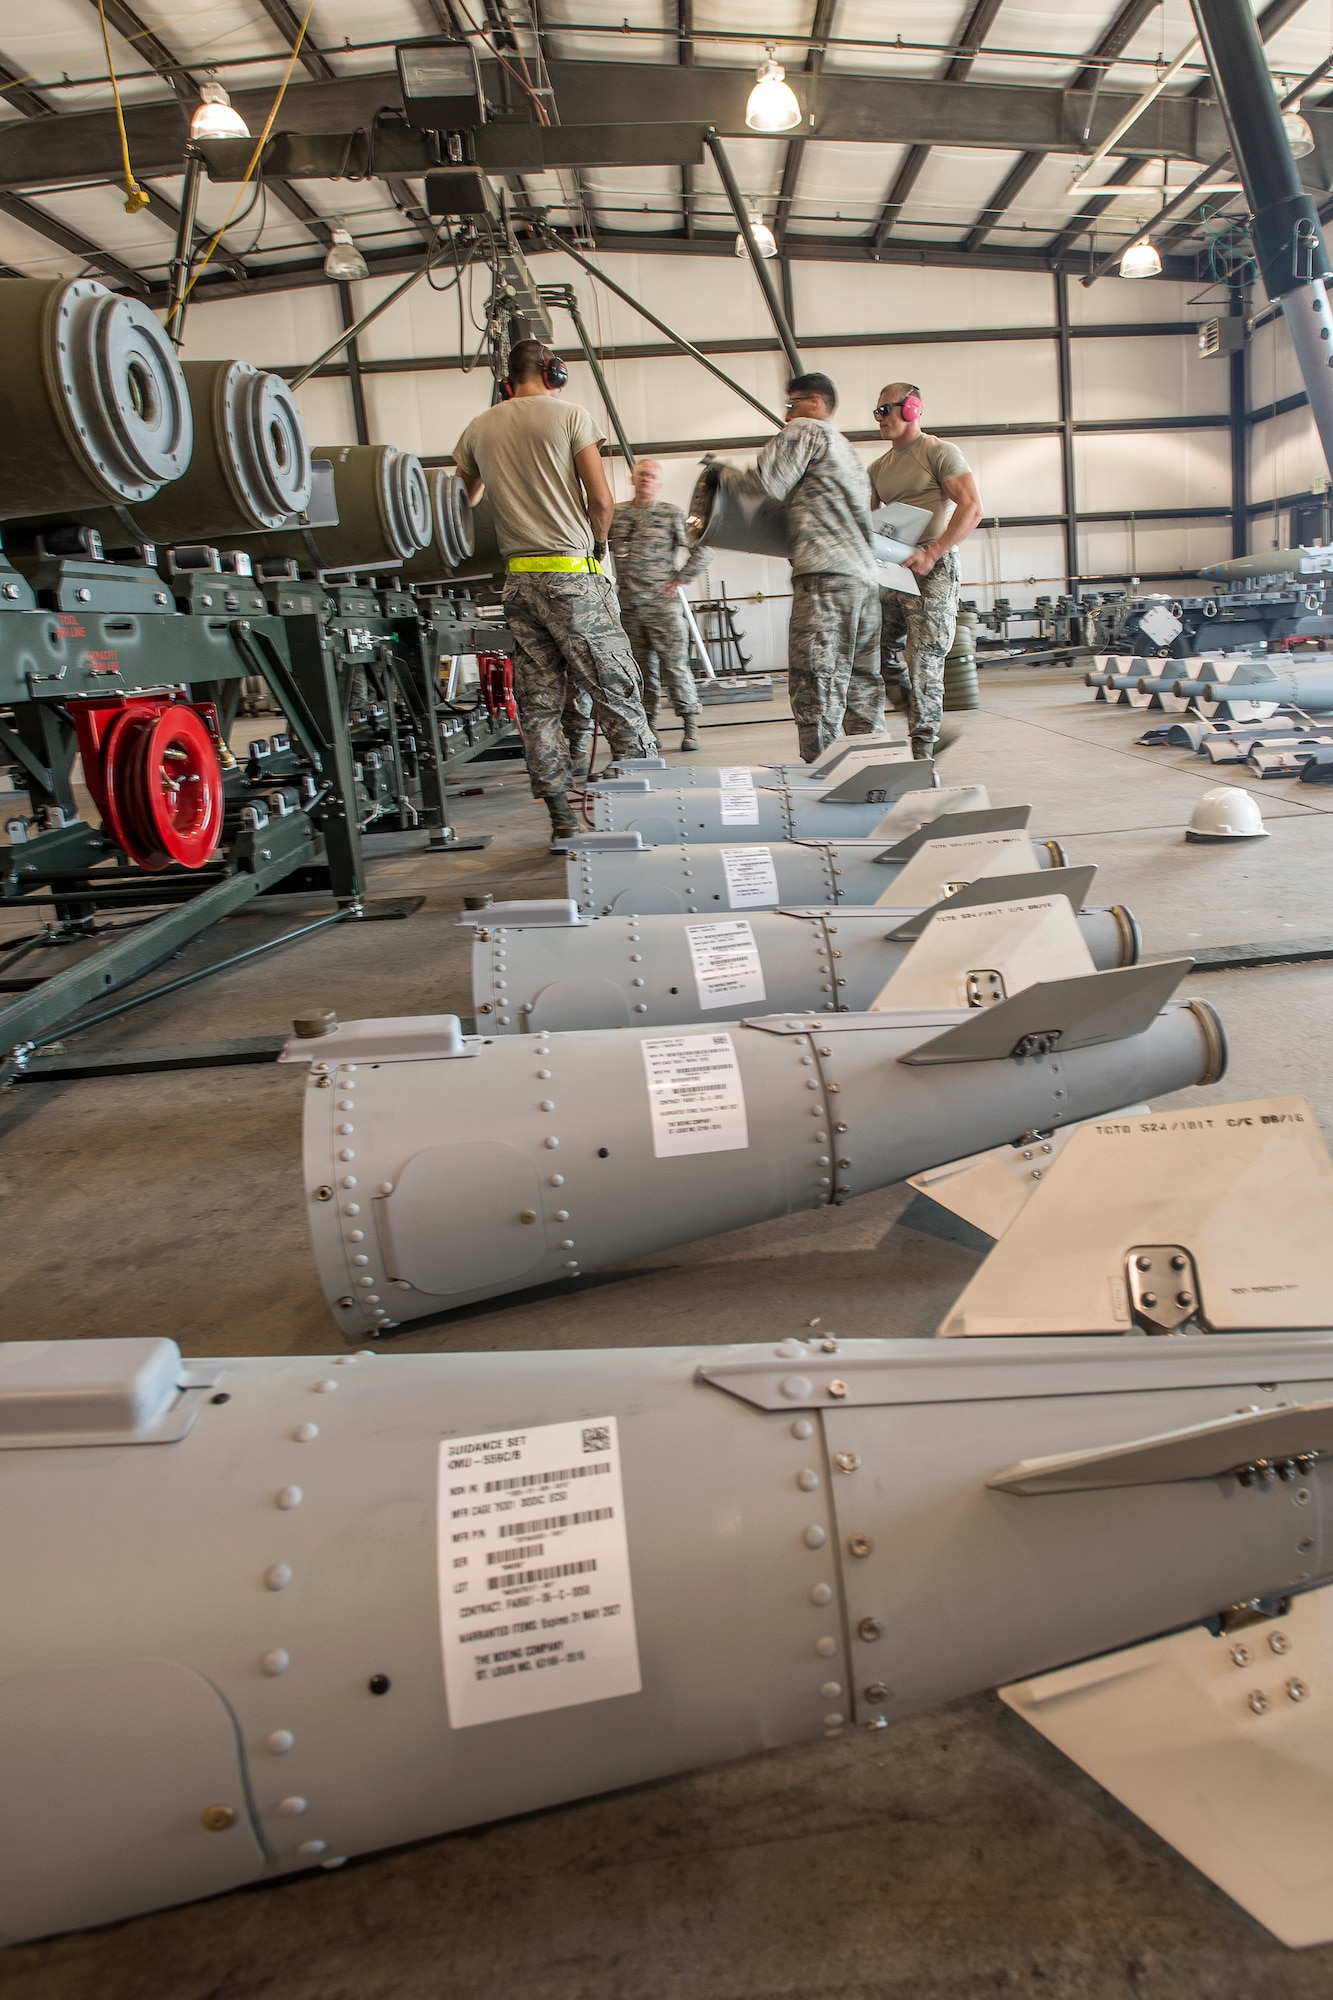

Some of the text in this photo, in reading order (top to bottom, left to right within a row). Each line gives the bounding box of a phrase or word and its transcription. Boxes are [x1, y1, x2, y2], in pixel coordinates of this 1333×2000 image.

[448, 1436, 527, 1456] GUIDANCE SET
[472, 1505, 491, 1516] CAGE
[459, 1625, 509, 1643] WARRANTED
[541, 1615, 569, 1630] Expires
[583, 1608, 599, 1620] MAY
[475, 1640, 565, 1666] THE BOEING COMPANY
[492, 1664, 515, 1678] LOUIS
